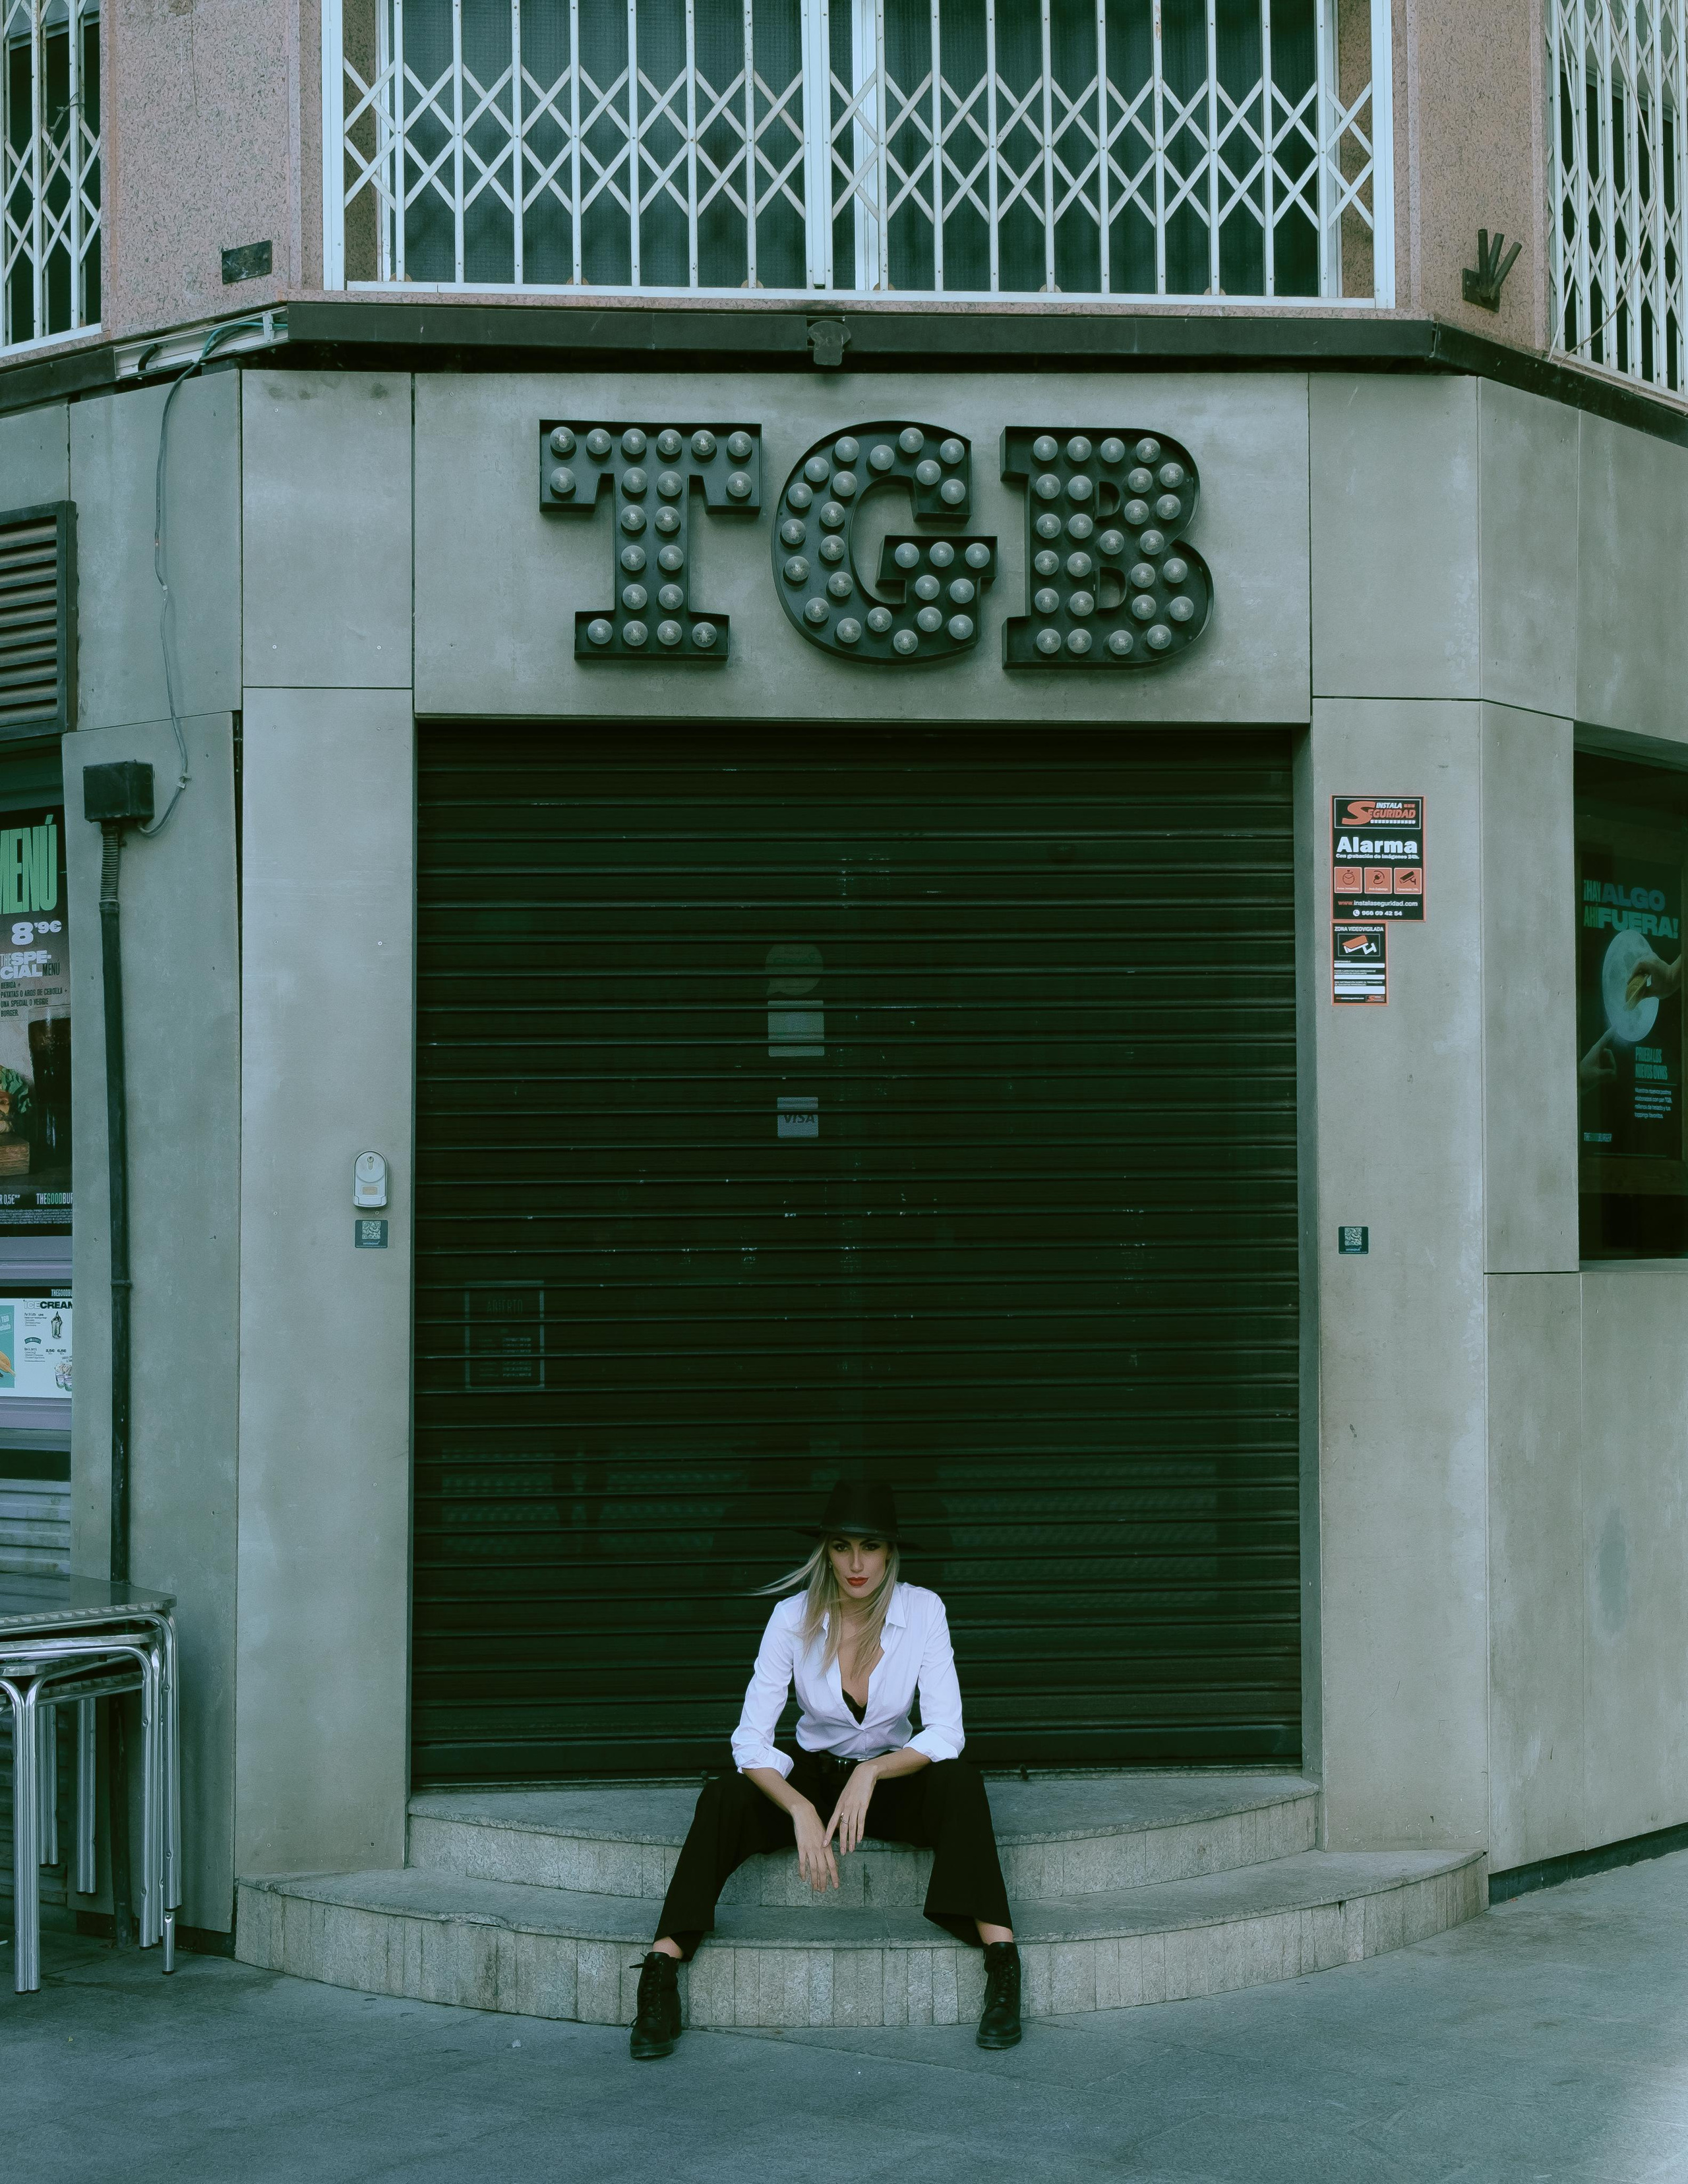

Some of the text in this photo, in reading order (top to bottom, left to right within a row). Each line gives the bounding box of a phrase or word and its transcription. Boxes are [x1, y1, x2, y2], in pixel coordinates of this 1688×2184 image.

[539, 419, 1214, 671] TGB
[1342, 801, 1416, 825] SEGURIDAD
[1337, 836, 1418, 853] Alarma
[1602, 883, 1666, 911] ALGO
[1598, 907, 1678, 939] FUERA!
[0, 959, 61, 980] CIAL MENÚ
[1, 953, 11, 967] THE
[44, 987, 63, 996] CEBOLLA
[784, 1114, 815, 1123] VISA
[487, 1299, 523, 1314] ABIERTO
